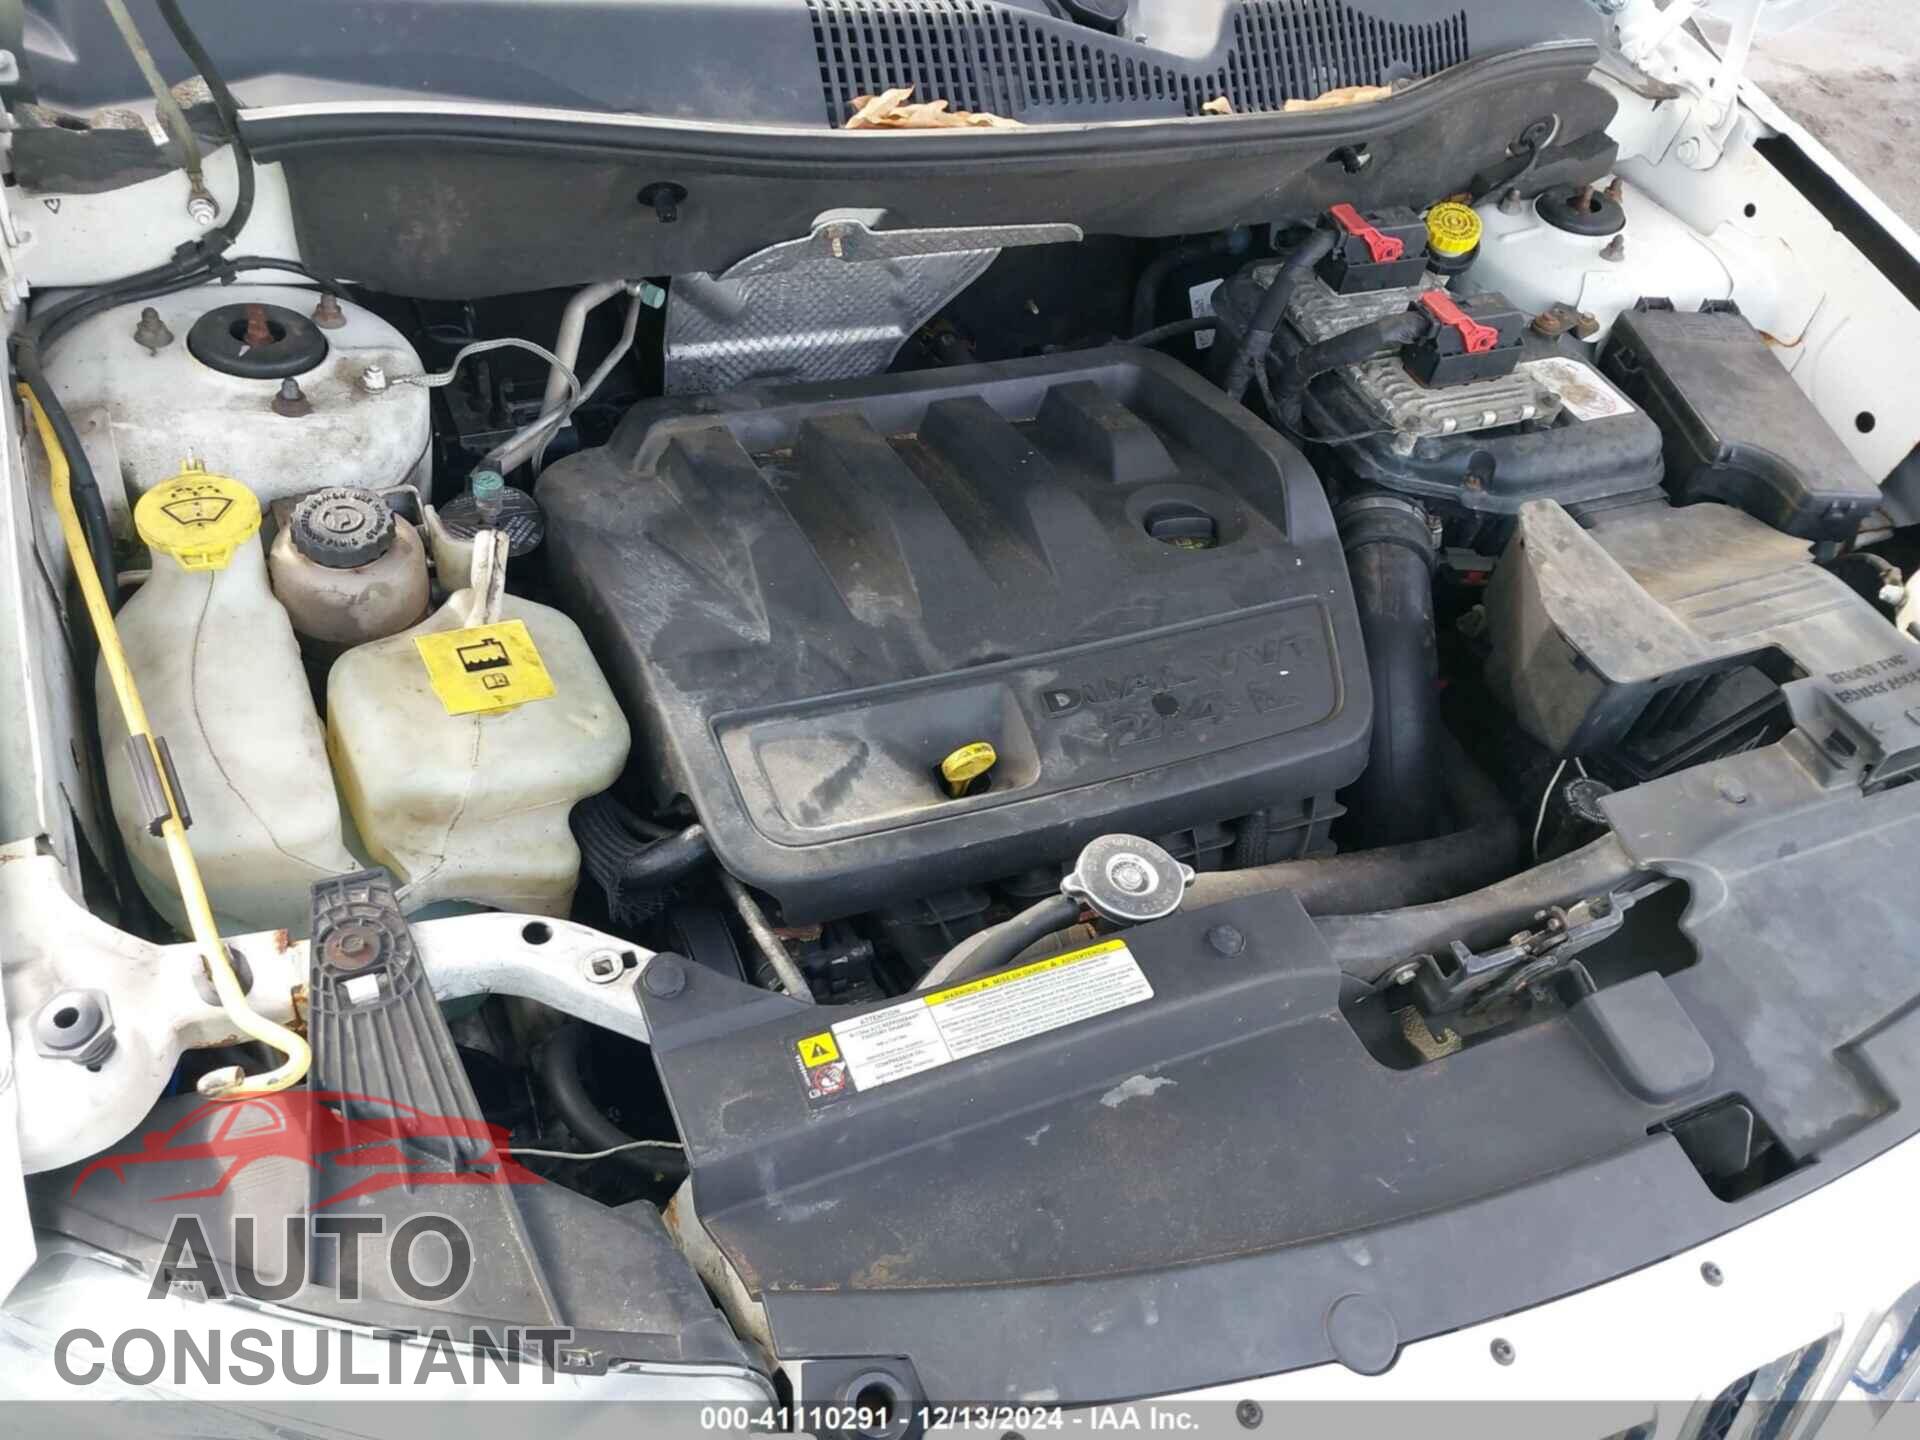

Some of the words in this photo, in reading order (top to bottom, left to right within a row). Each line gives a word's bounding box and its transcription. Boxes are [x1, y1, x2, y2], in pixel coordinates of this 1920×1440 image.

[1042, 658, 1197, 718] DUAL
[942, 984, 979, 1001] WARNING
[859, 1007, 901, 1026] ATTENTION
